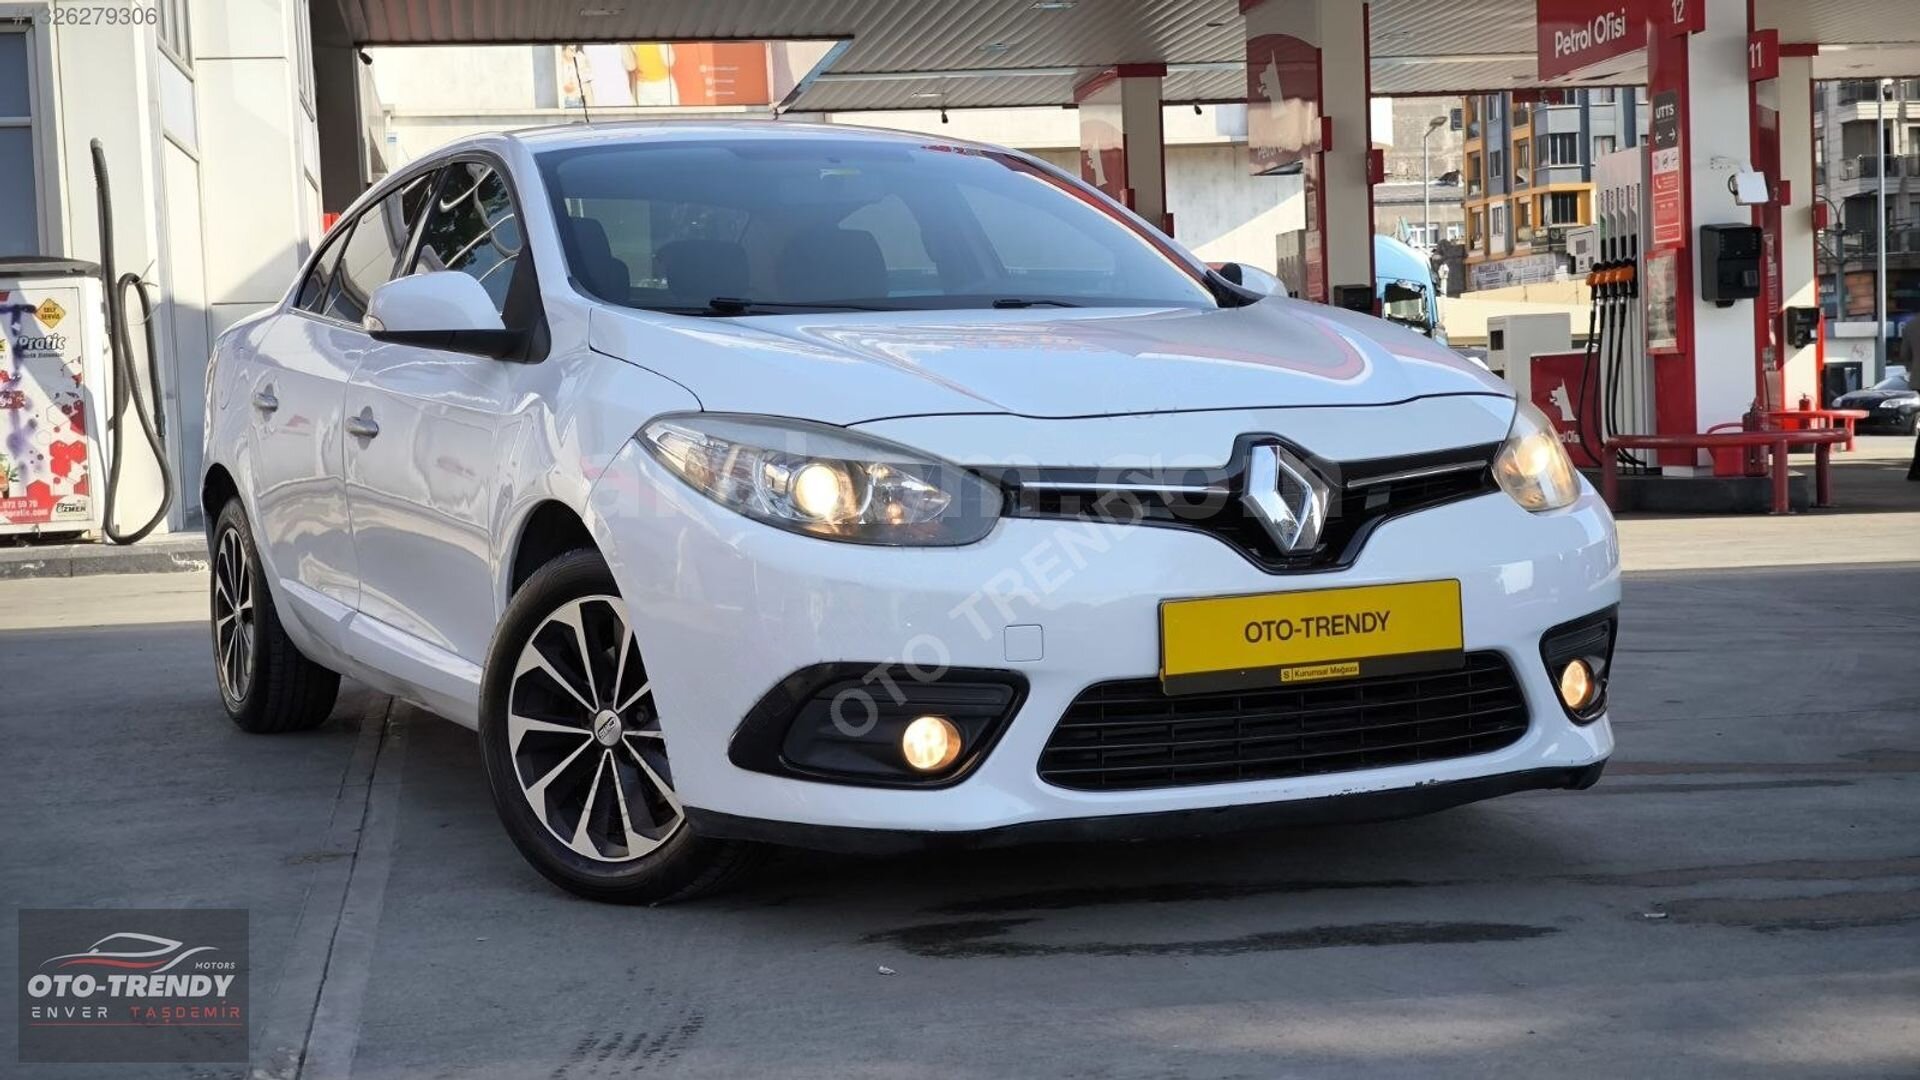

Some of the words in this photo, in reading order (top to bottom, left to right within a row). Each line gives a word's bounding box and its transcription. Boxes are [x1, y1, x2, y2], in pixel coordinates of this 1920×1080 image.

[1671, 0, 1685, 24] 12
[1554, 19, 1592, 58] Petrol
[1594, 8, 1626, 45] Ofisi
[1749, 41, 1762, 69] 11
[1655, 103, 1675, 120] UTTS
[16, 333, 67, 350] Pratic
[1244, 610, 1391, 643] OTO-TRENDY
[1294, 667, 1329, 678] Kurumsal
[1330, 665, 1358, 676] Mağaza
